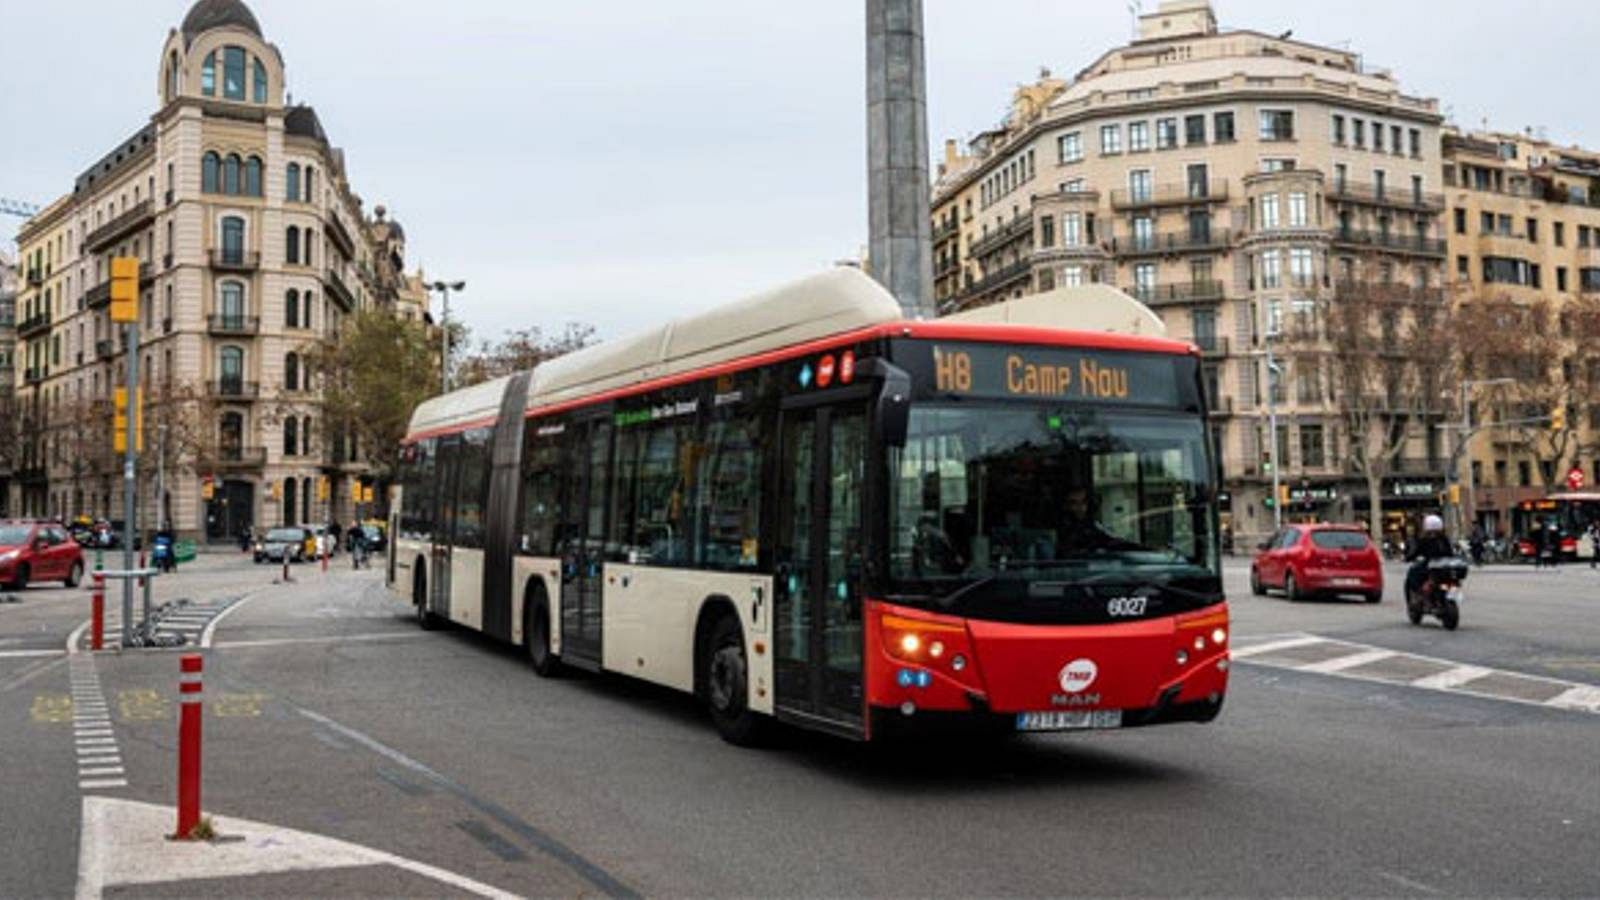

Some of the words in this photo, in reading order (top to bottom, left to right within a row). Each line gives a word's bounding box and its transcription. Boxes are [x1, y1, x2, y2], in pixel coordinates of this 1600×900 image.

[935, 351, 972, 391] H8
[1007, 355, 1072, 395] Camp
[1079, 358, 1128, 397] Nou
[1107, 597, 1147, 616] 6027
